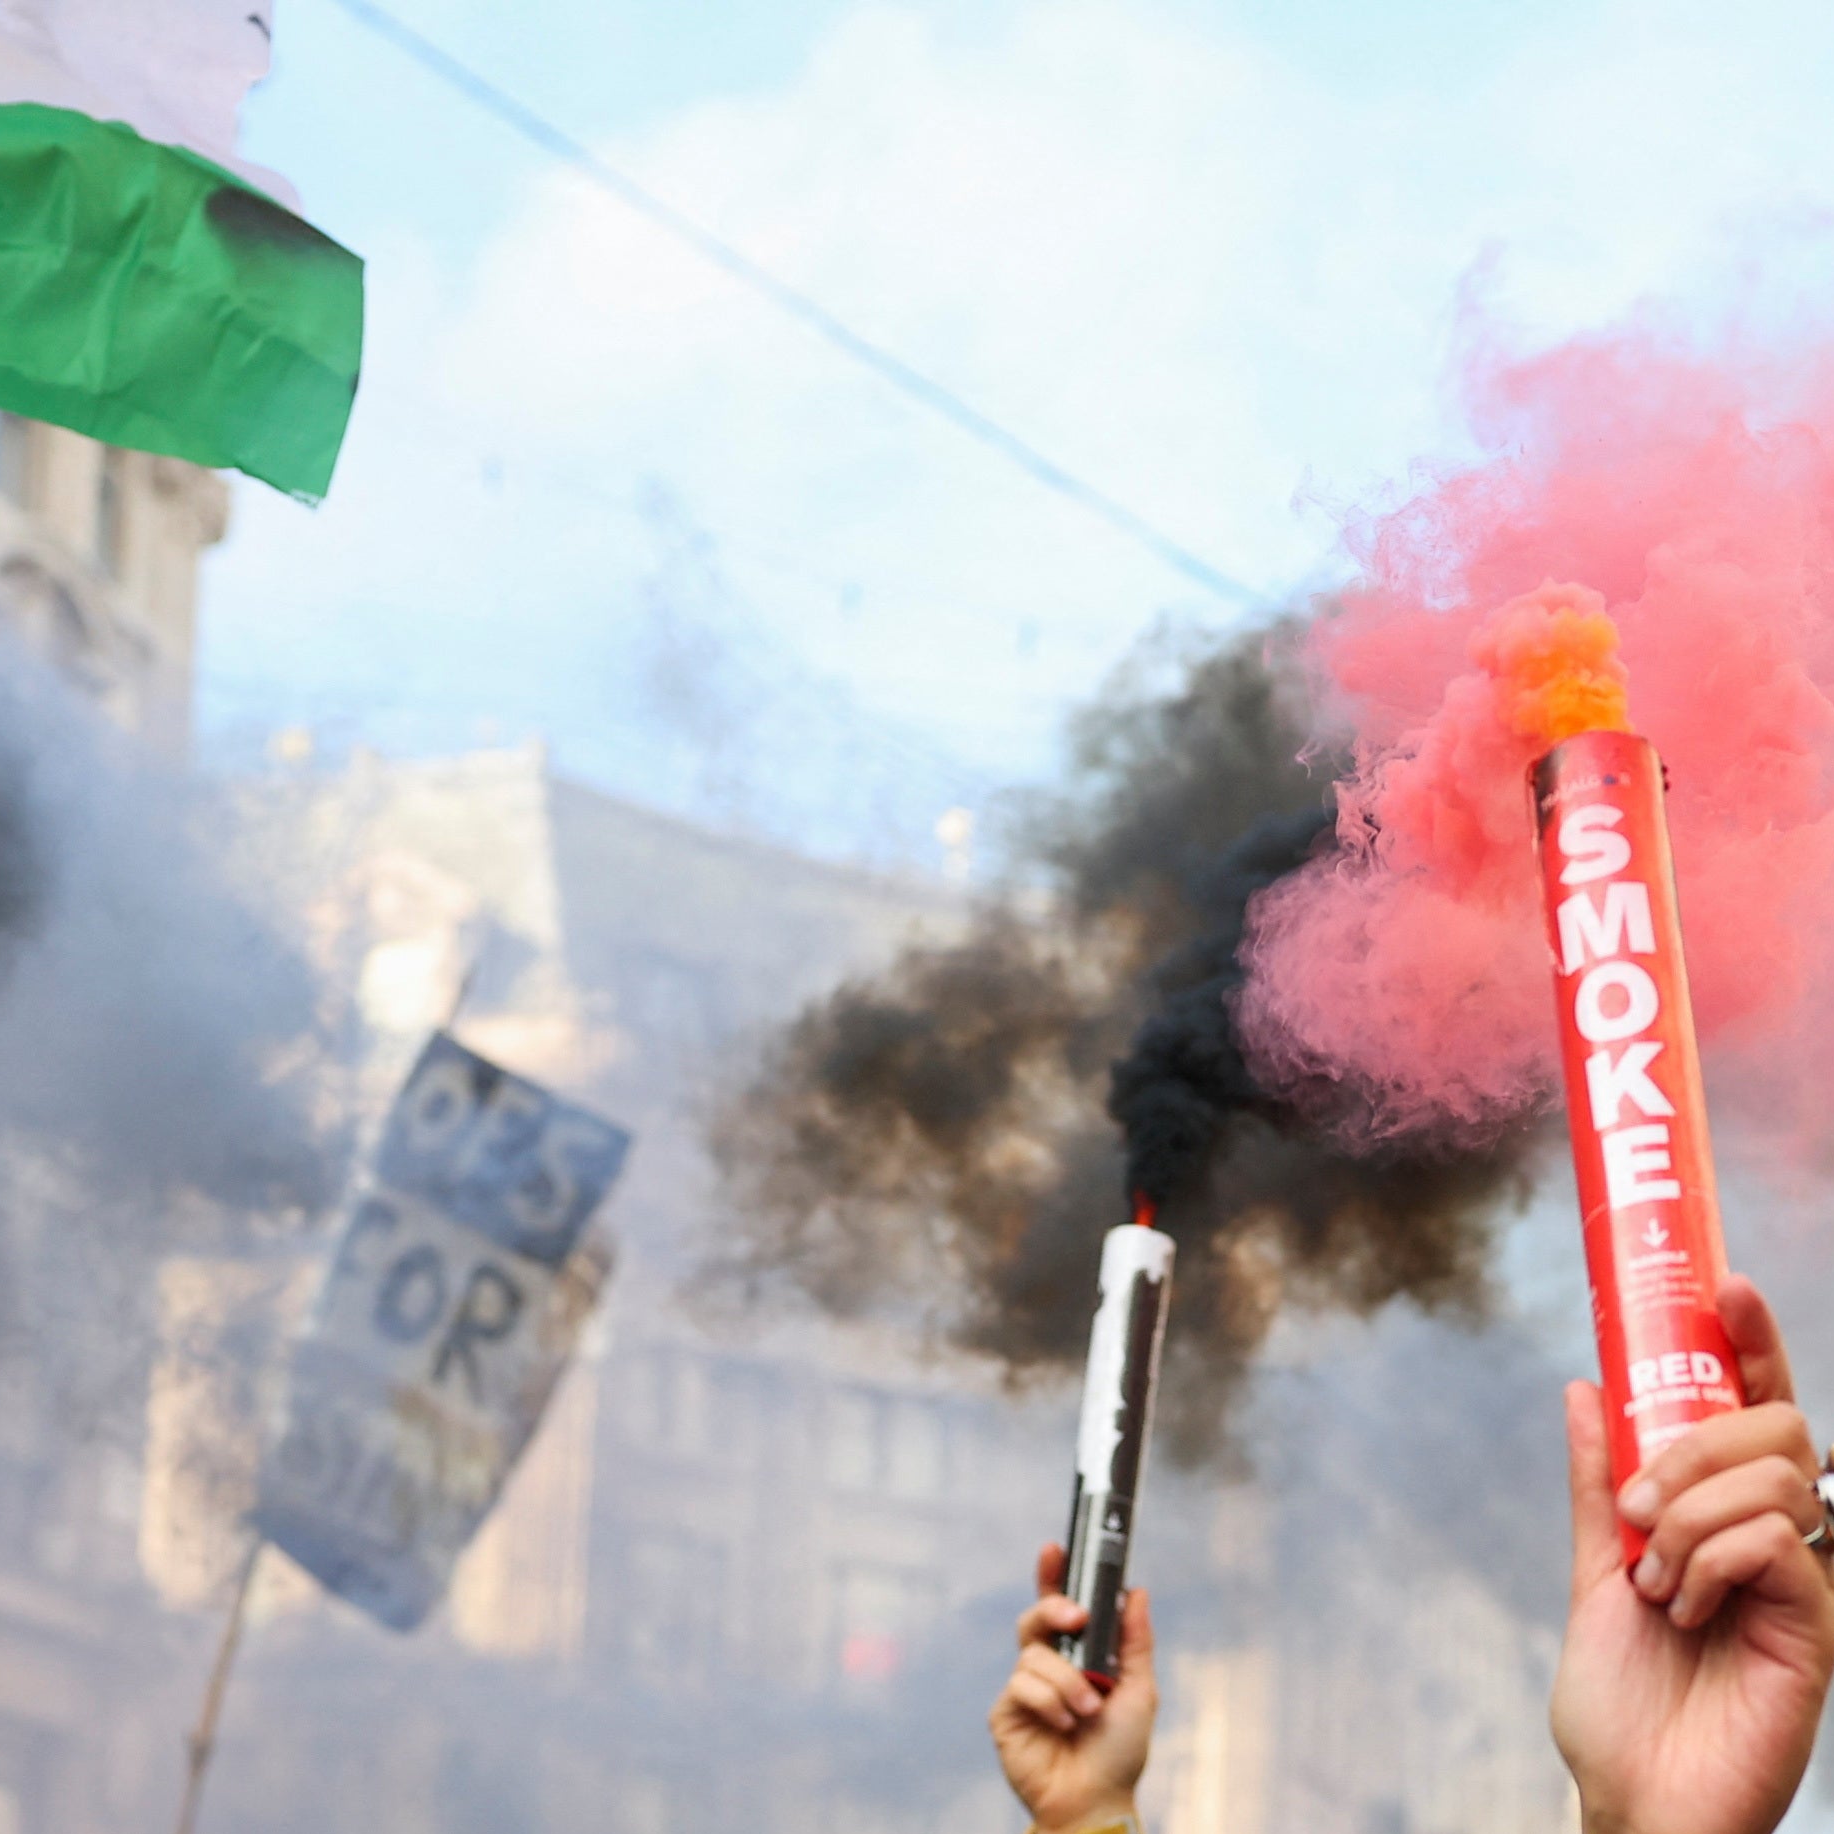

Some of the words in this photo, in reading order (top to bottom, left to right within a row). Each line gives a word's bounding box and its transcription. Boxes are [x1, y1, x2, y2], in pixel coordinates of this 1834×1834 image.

[1558, 803, 1681, 1213] SMOKE
[333, 1198, 525, 1402] FOR
[1628, 1351, 1723, 1396] RED
